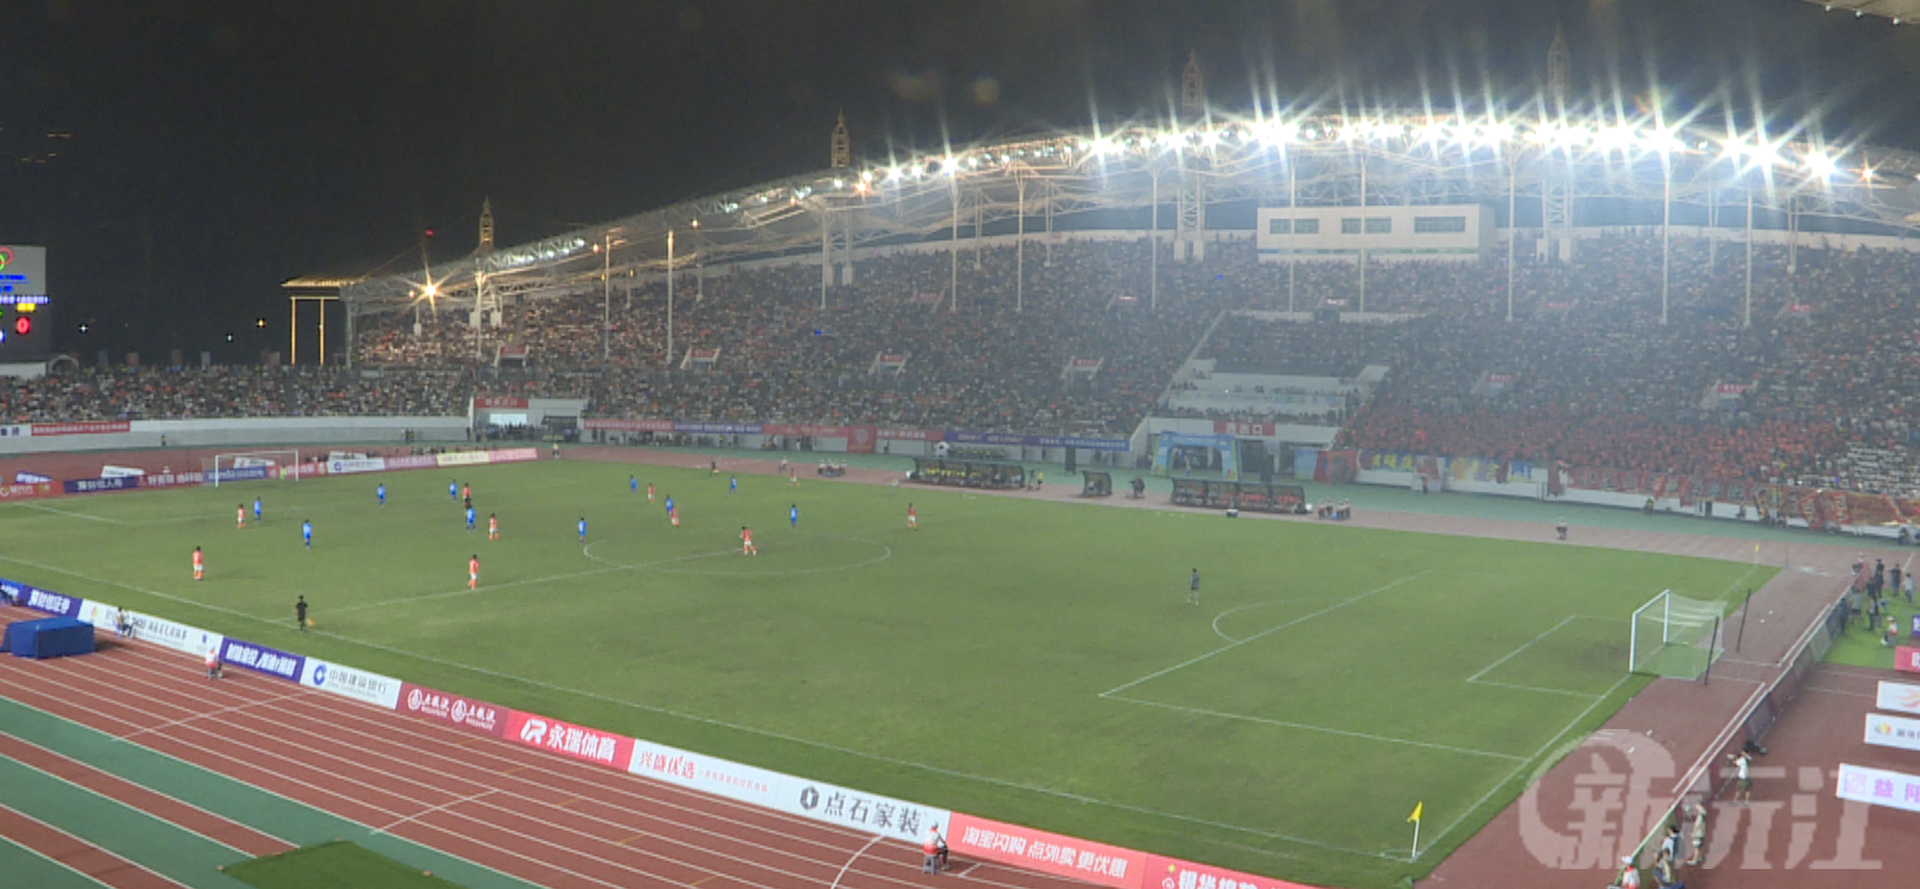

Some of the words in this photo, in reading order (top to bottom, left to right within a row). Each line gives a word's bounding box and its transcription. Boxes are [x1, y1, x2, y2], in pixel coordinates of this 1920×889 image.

[17, 316, 30, 334] 0
[328, 669, 387, 694] 中国建设银行
[548, 726, 615, 762] 永瑞体育
[640, 752, 695, 780] 兴盛优选
[823, 790, 923, 836] 点石家装
[962, 826, 1027, 856] 淘宝闪购
[1027, 840, 1078, 869] 点外卖
[1077, 852, 1129, 879] 更优惠
